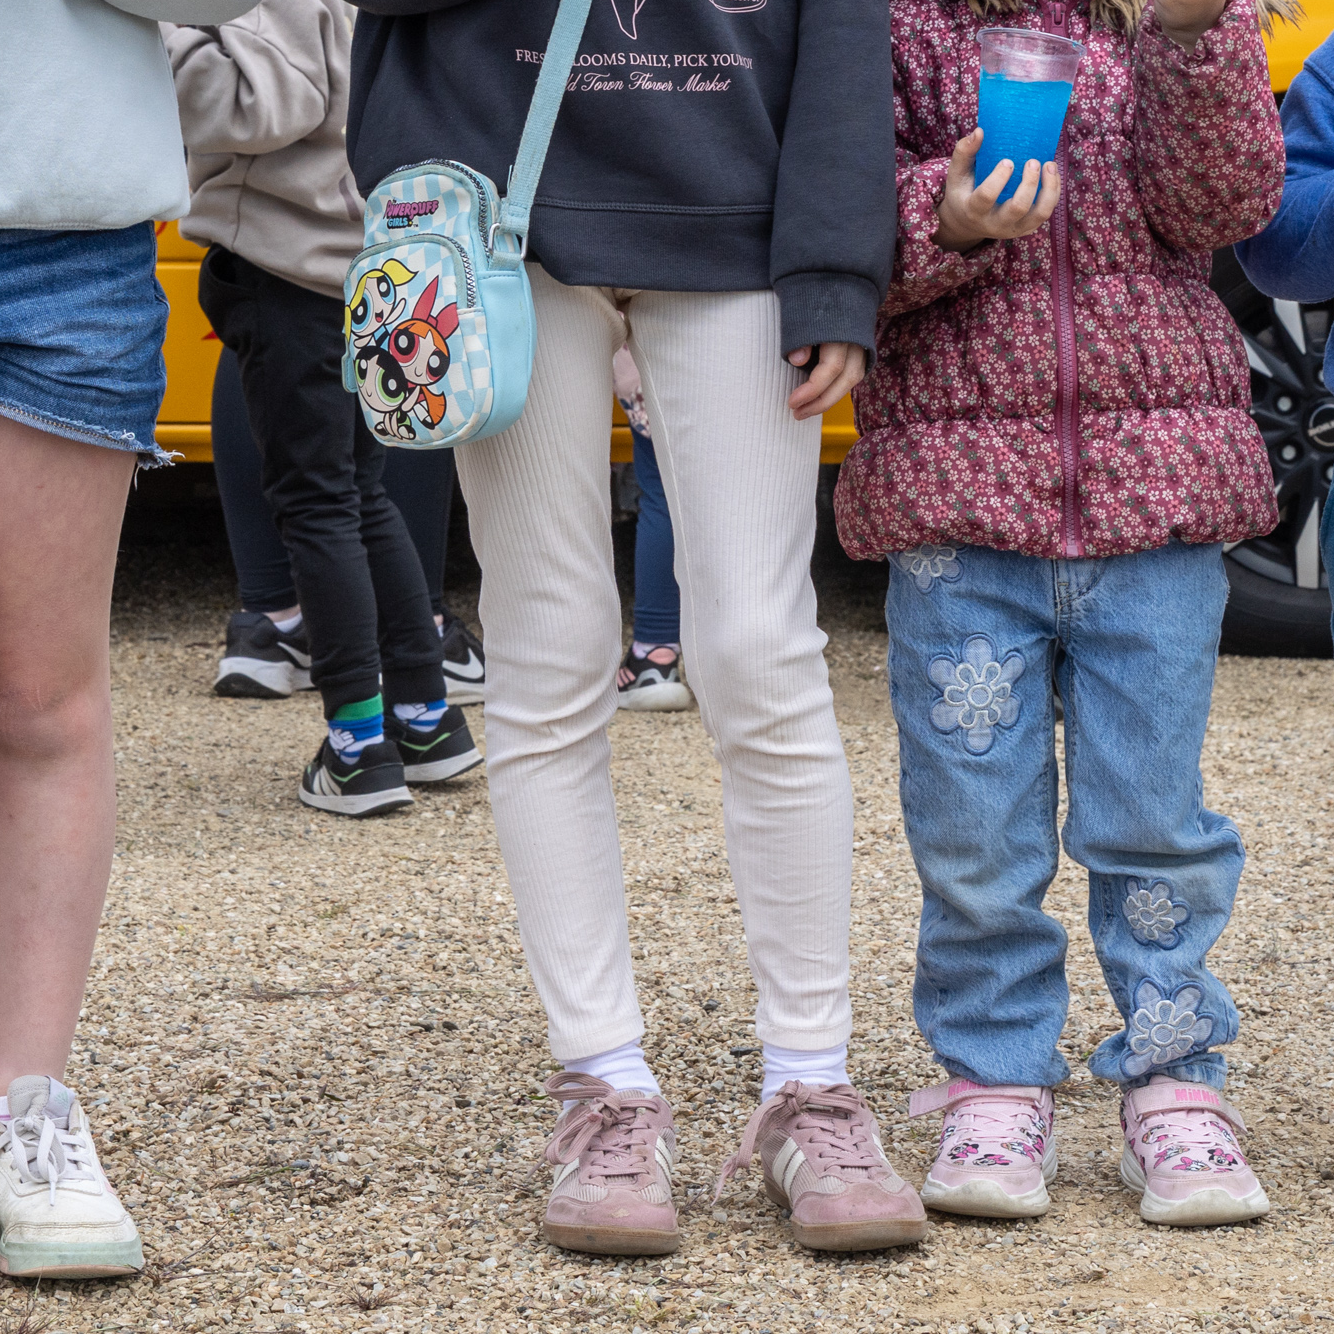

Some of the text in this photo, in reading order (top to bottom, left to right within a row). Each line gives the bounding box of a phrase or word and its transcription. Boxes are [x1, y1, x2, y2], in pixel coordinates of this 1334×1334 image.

[515, 49, 545, 65] FRES
[630, 52, 671, 69] DAILY,
[674, 54, 709, 67] PICK
[581, 71, 625, 92] Town
[628, 71, 673, 92] Flower
[677, 72, 732, 92] Market
[383, 200, 439, 220] POWERPUFF
[387, 217, 409, 229] GIRLS
